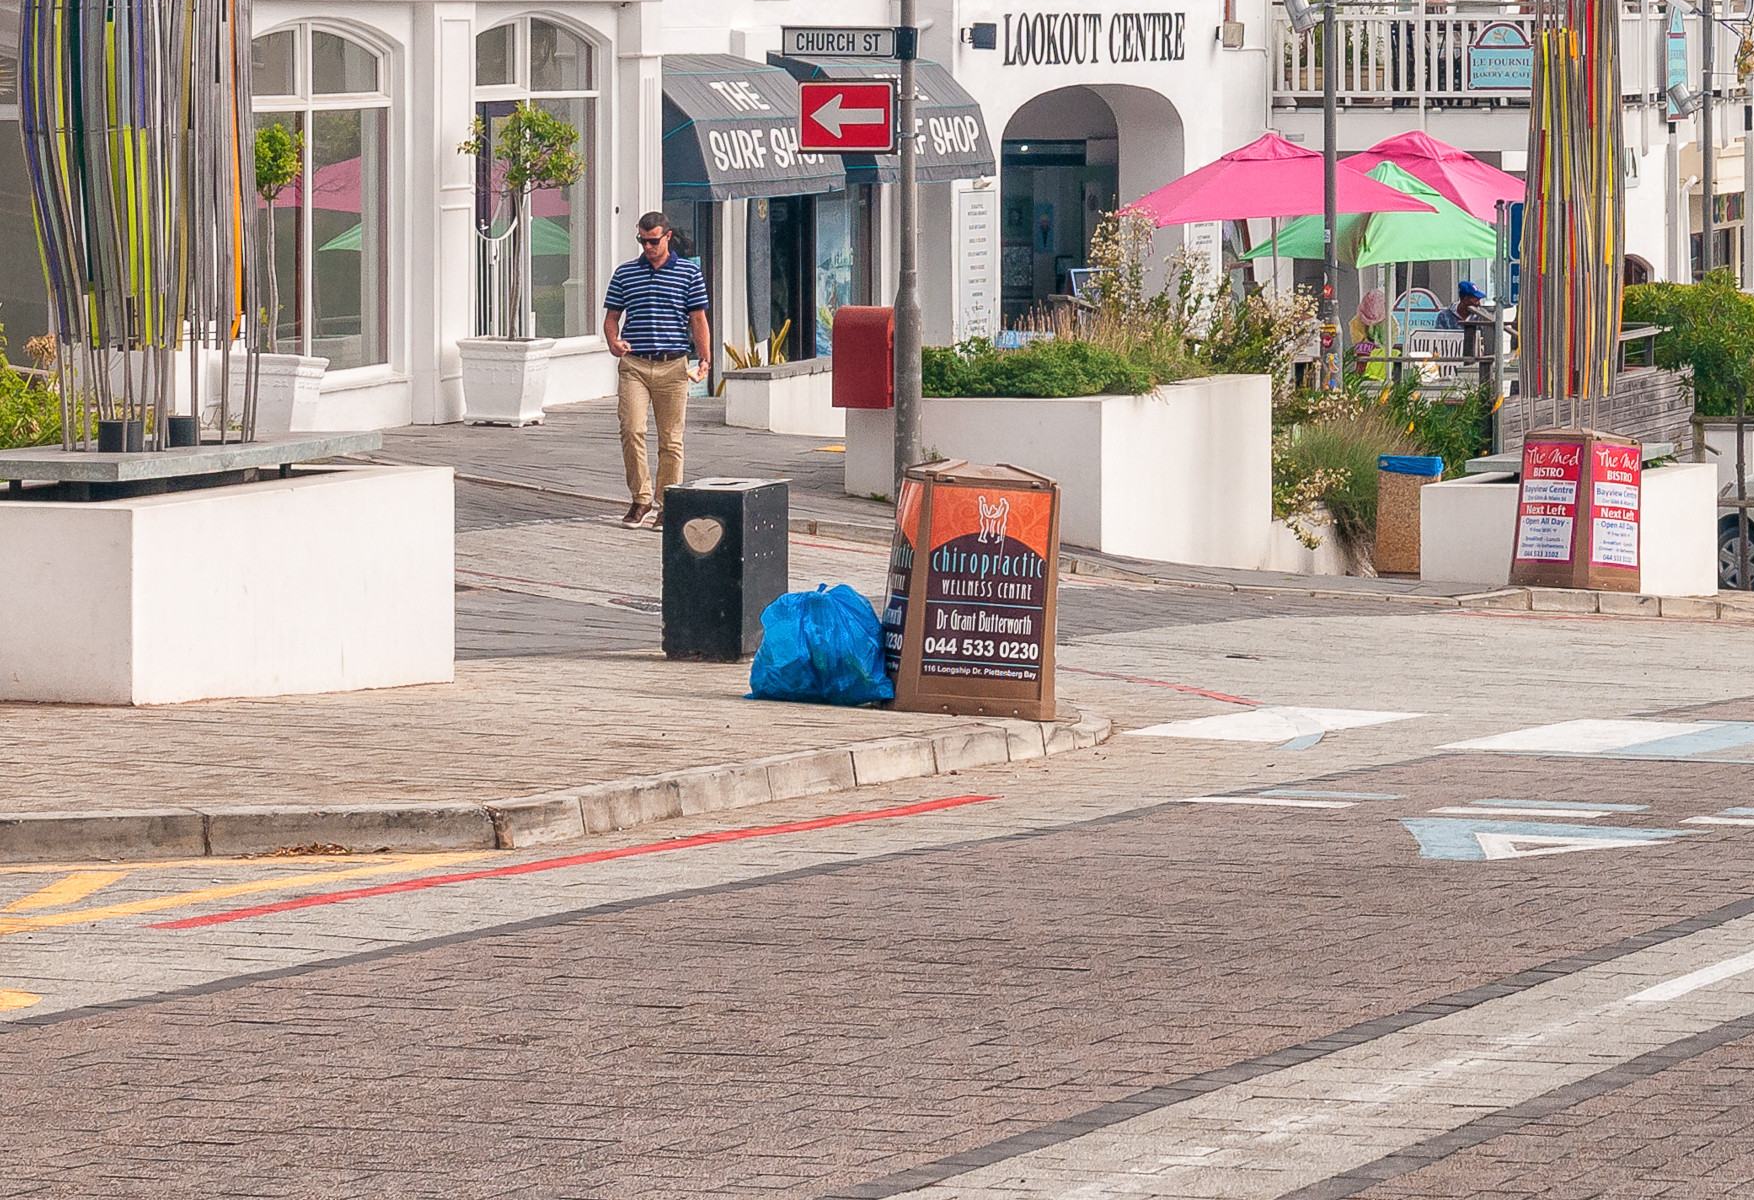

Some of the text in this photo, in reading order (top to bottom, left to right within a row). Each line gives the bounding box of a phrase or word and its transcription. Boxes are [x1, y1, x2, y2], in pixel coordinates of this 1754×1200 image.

[796, 33, 881, 52] CHURCH ST
[1003, 12, 1186, 66] LOOKOUT CENTRE
[709, 80, 770, 112] THE
[928, 115, 980, 156] SHOP
[708, 128, 766, 172] SURF
[1527, 447, 1580, 466] The Med
[1596, 448, 1618, 468] The
[1533, 467, 1564, 478] BISTRO
[1607, 470, 1633, 483] BISTRO
[1548, 485, 1574, 494] Centre
[1596, 487, 1622, 498] Bayview
[1526, 504, 1566, 516] Next Left
[1601, 507, 1622, 519] Next
[1525, 517, 1565, 527] Open All Day
[1600, 520, 1617, 530] Open
[932, 545, 1043, 579] chiropractic
[942, 579, 1032, 601] WELLNESS CENTRE
[936, 608, 1032, 636] Dr Grant Butterworth
[924, 637, 1039, 660] 044 533 0230
[924, 664, 936, 673] 116
[937, 665, 970, 676] Longship
[983, 668, 1023, 680] Plettenberg
[1024, 670, 1037, 681] Bay
